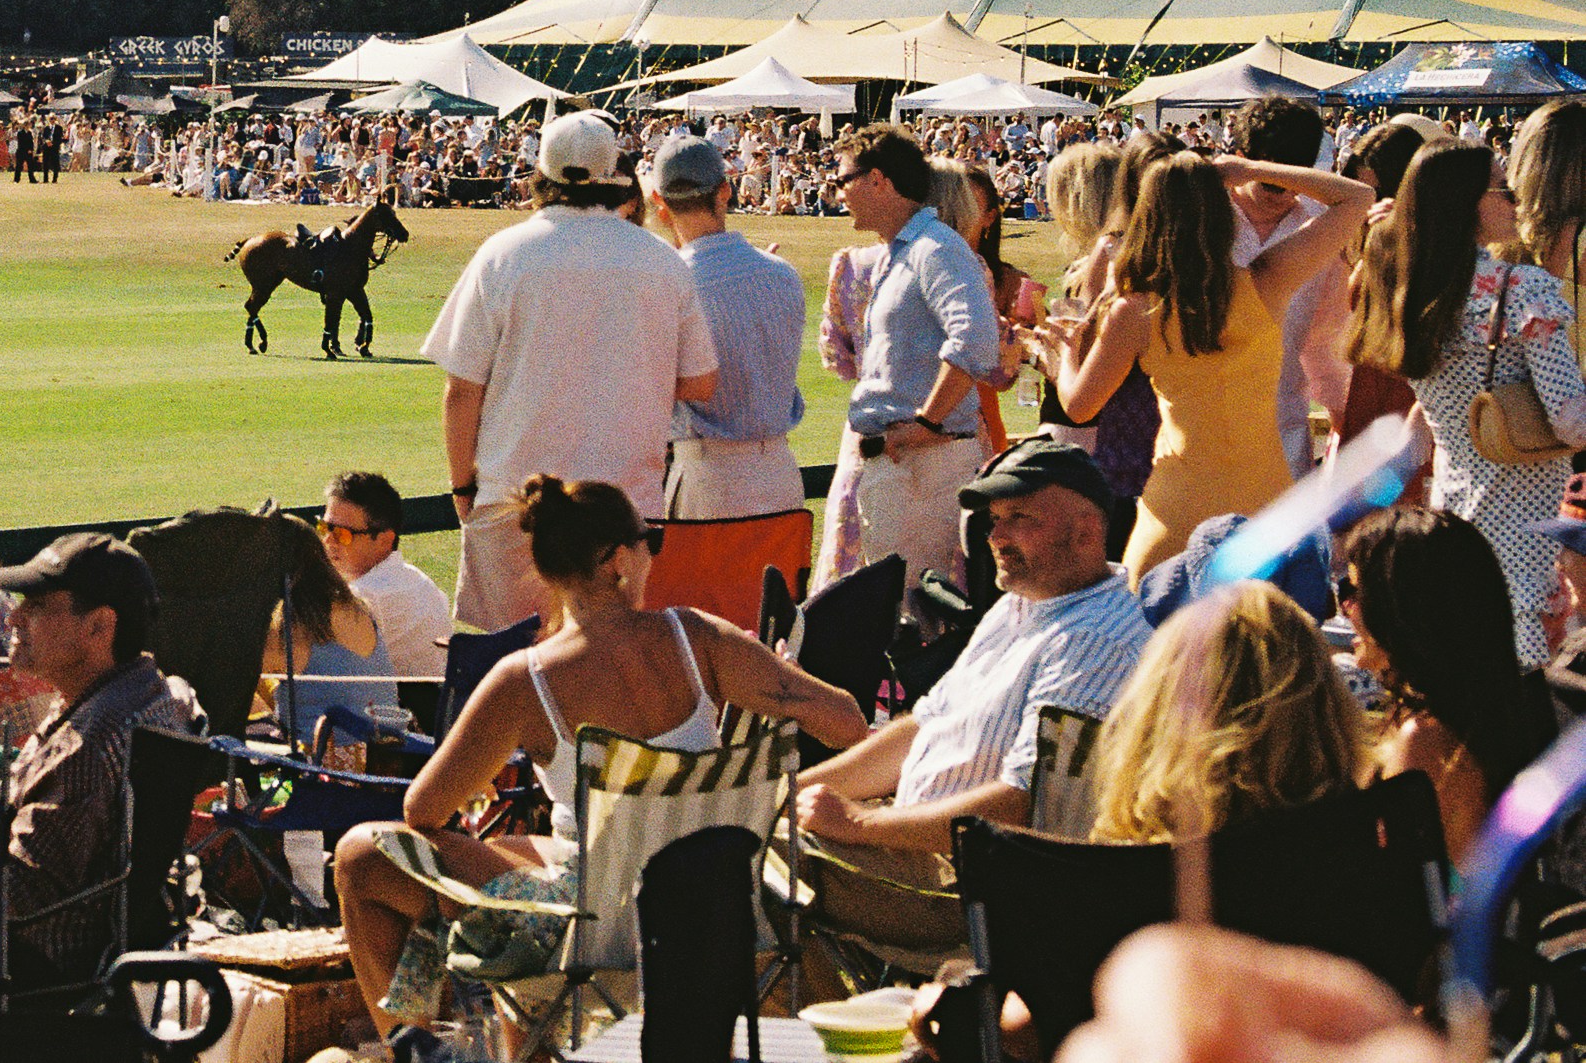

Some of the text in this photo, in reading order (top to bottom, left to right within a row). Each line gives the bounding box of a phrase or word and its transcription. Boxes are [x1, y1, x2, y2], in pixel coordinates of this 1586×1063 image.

[118, 38, 225, 55] GREEK GYROS
[286, 39, 353, 52] CHICKEN
